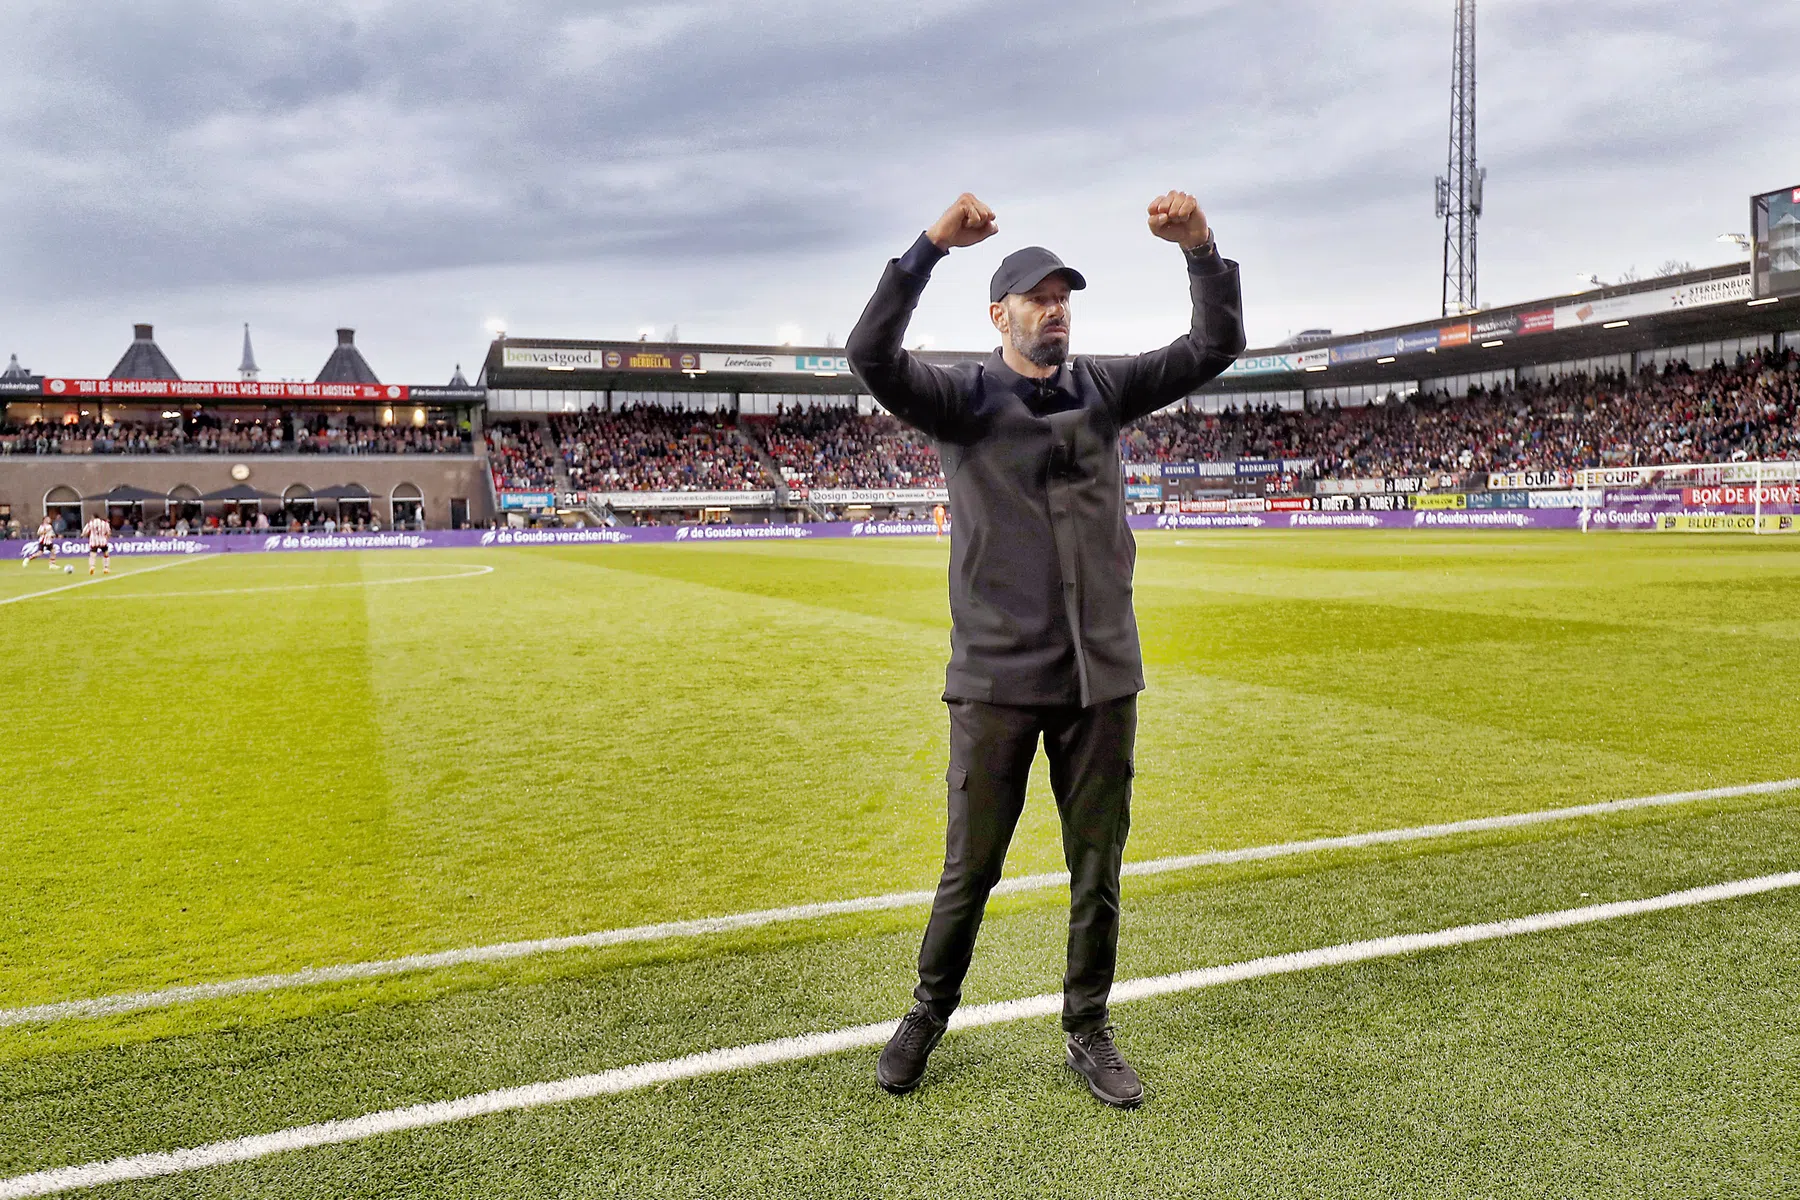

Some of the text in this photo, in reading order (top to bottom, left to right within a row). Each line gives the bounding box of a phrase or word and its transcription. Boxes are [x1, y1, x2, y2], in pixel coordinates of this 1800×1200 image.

[1233, 355, 1291, 371] LOGIX
[99, 381, 111, 393] DE
[217, 382, 239, 394] VEEL
[240, 383, 259, 394] WEG
[287, 384, 304, 395] VAN
[305, 384, 321, 395] HET
[1125, 463, 1161, 477] WOONING
[1165, 466, 1195, 474] KEUKENS
[1199, 462, 1236, 476] WOONING
[1239, 462, 1279, 473] BADKAMERS
[1395, 477, 1420, 492] ROBEY
[565, 493, 578, 504] 21
[789, 490, 801, 500] 22
[852, 491, 884, 501] Dosign
[1692, 488, 1721, 503] BOK
[1725, 488, 1744, 503] DE
[1370, 495, 1395, 509] ROBEY
[1179, 515, 1211, 525] Goudse
[1298, 514, 1307, 525] de
[1308, 513, 1332, 525] Goudse
[1425, 512, 1436, 524] de
[1437, 511, 1468, 524] Goudse
[1593, 509, 1607, 523] de
[1608, 509, 1650, 523] Goudse
[690, 528, 704, 538] de
[705, 526, 742, 538] Goudse
[865, 523, 877, 534] de
[878, 523, 911, 533] Goudse
[282, 536, 300, 548] de
[301, 534, 348, 547] Goudse
[497, 532, 512, 543] de
[514, 531, 555, 542] Goudse
